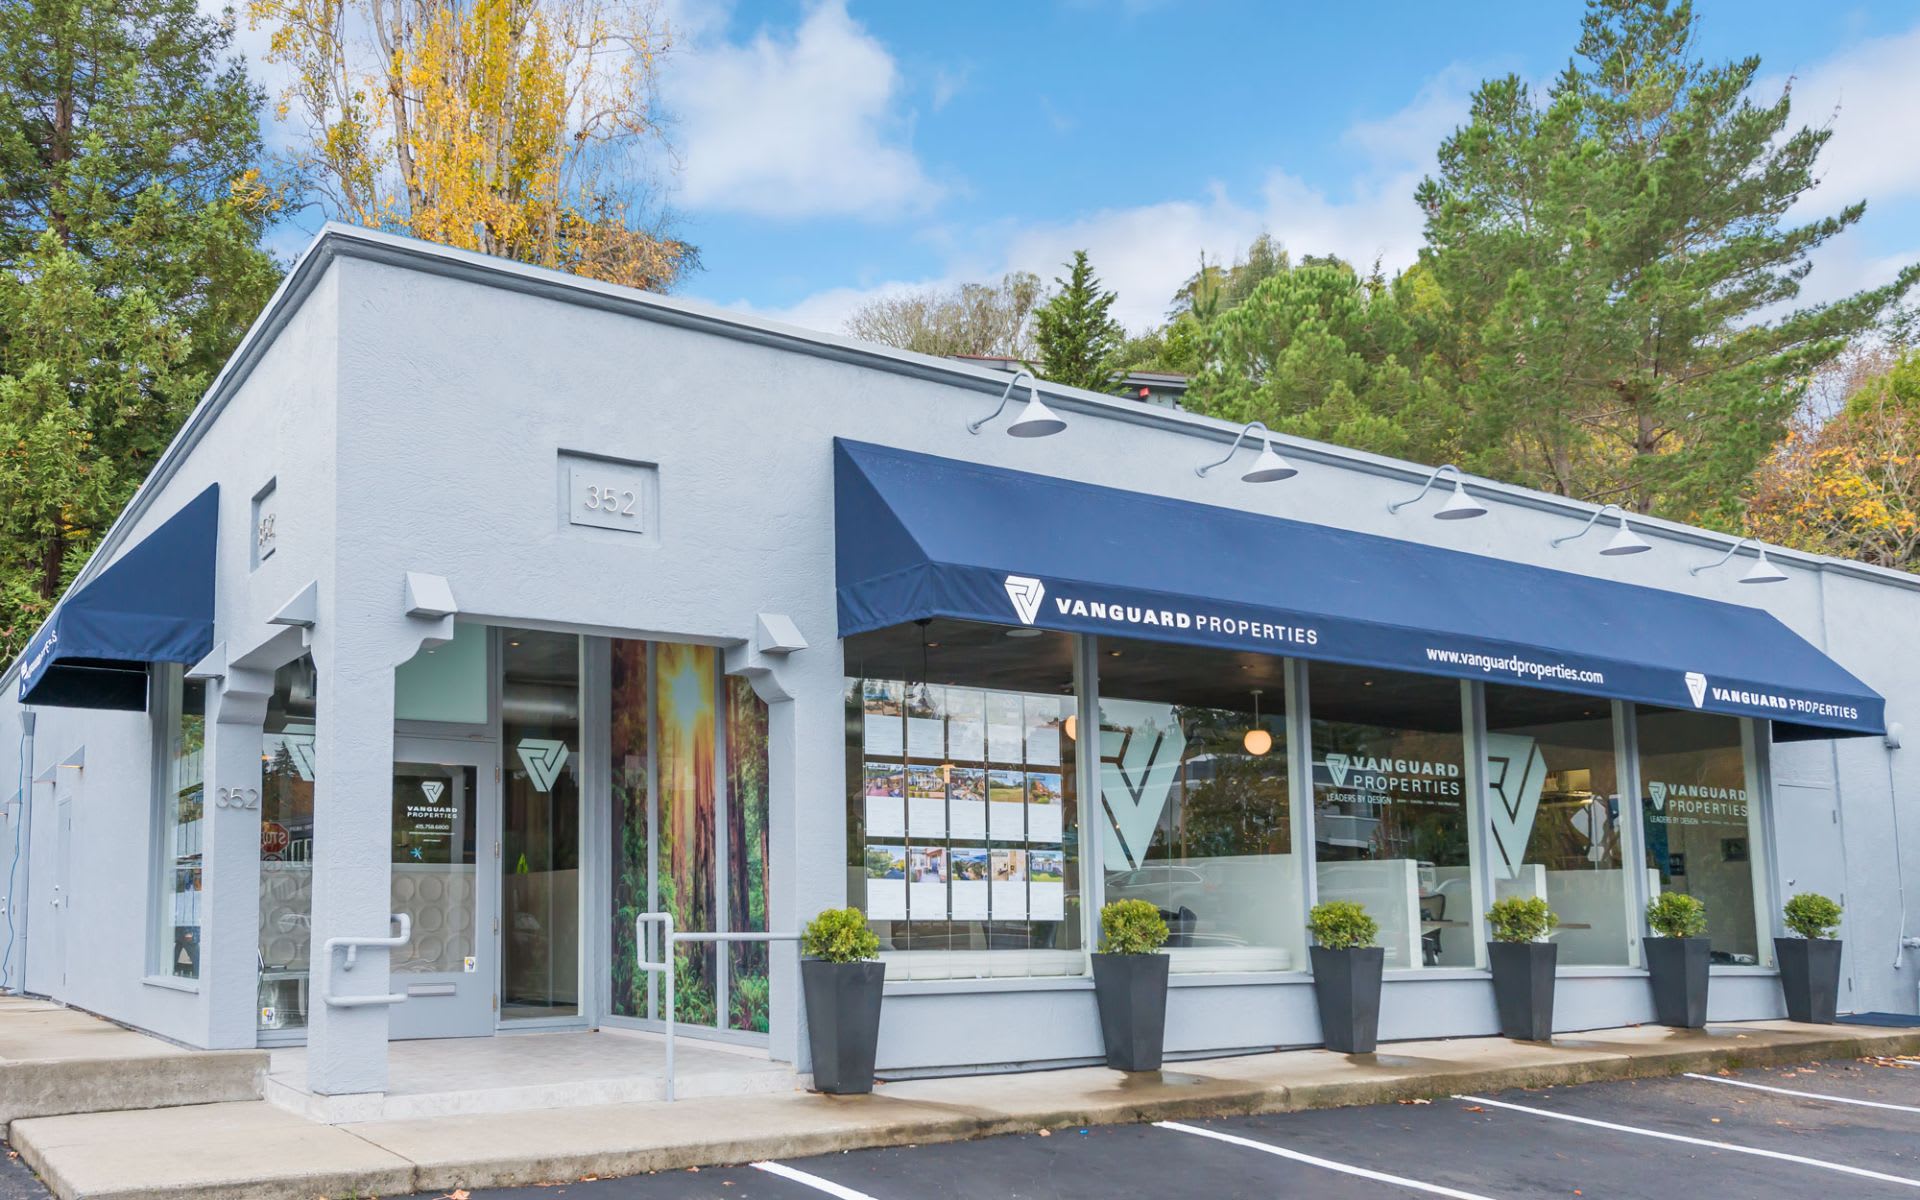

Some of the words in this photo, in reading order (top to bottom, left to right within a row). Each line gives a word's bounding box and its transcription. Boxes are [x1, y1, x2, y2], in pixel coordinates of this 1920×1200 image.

[584, 484, 637, 517] 352
[1055, 597, 1191, 629] VANGUARD
[1196, 615, 1318, 645] PROPERTIES
[1426, 648, 1604, 684] www.vanguardproperties.com
[1712, 687, 1788, 709] VANGUARD
[1789, 698, 1858, 720] PROPERTIES
[1352, 756, 1459, 777] VANGUARD
[1353, 775, 1460, 796] PROPERTIES
[1668, 784, 1747, 801] VANGUARD
[215, 787, 258, 810] 352
[1326, 793, 1356, 802] LEADERS
[1357, 795, 1366, 803] BY
[1367, 795, 1392, 805] DESIGN
[1669, 799, 1748, 817] PROPERTIES
[407, 811, 458, 819] PROPERTIES
